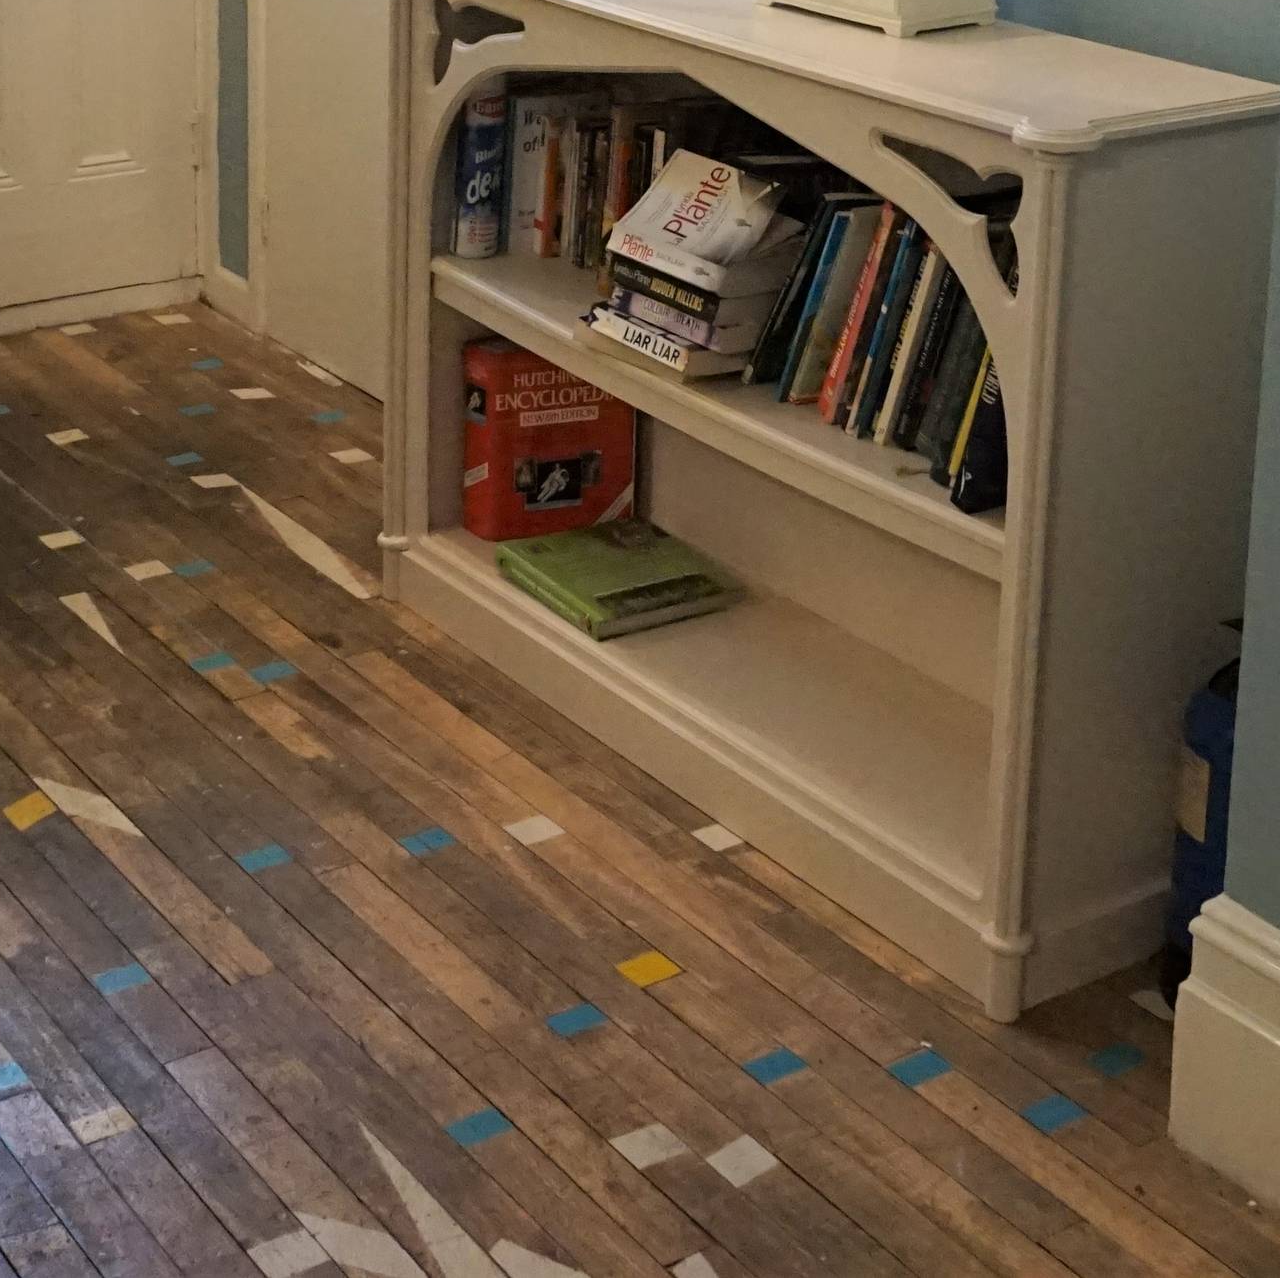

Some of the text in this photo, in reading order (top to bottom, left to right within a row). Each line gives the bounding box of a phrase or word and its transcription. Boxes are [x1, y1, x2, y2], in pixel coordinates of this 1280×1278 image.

[662, 167, 731, 238] Plante
[620, 233, 654, 261] Plante
[675, 287, 704, 312] KILLERS
[623, 326, 681, 365] LIAR LIAR
[830, 326, 849, 379] ANYTHING
[513, 370, 580, 387] HUTCHIN
[561, 407, 597, 421] EDITION
